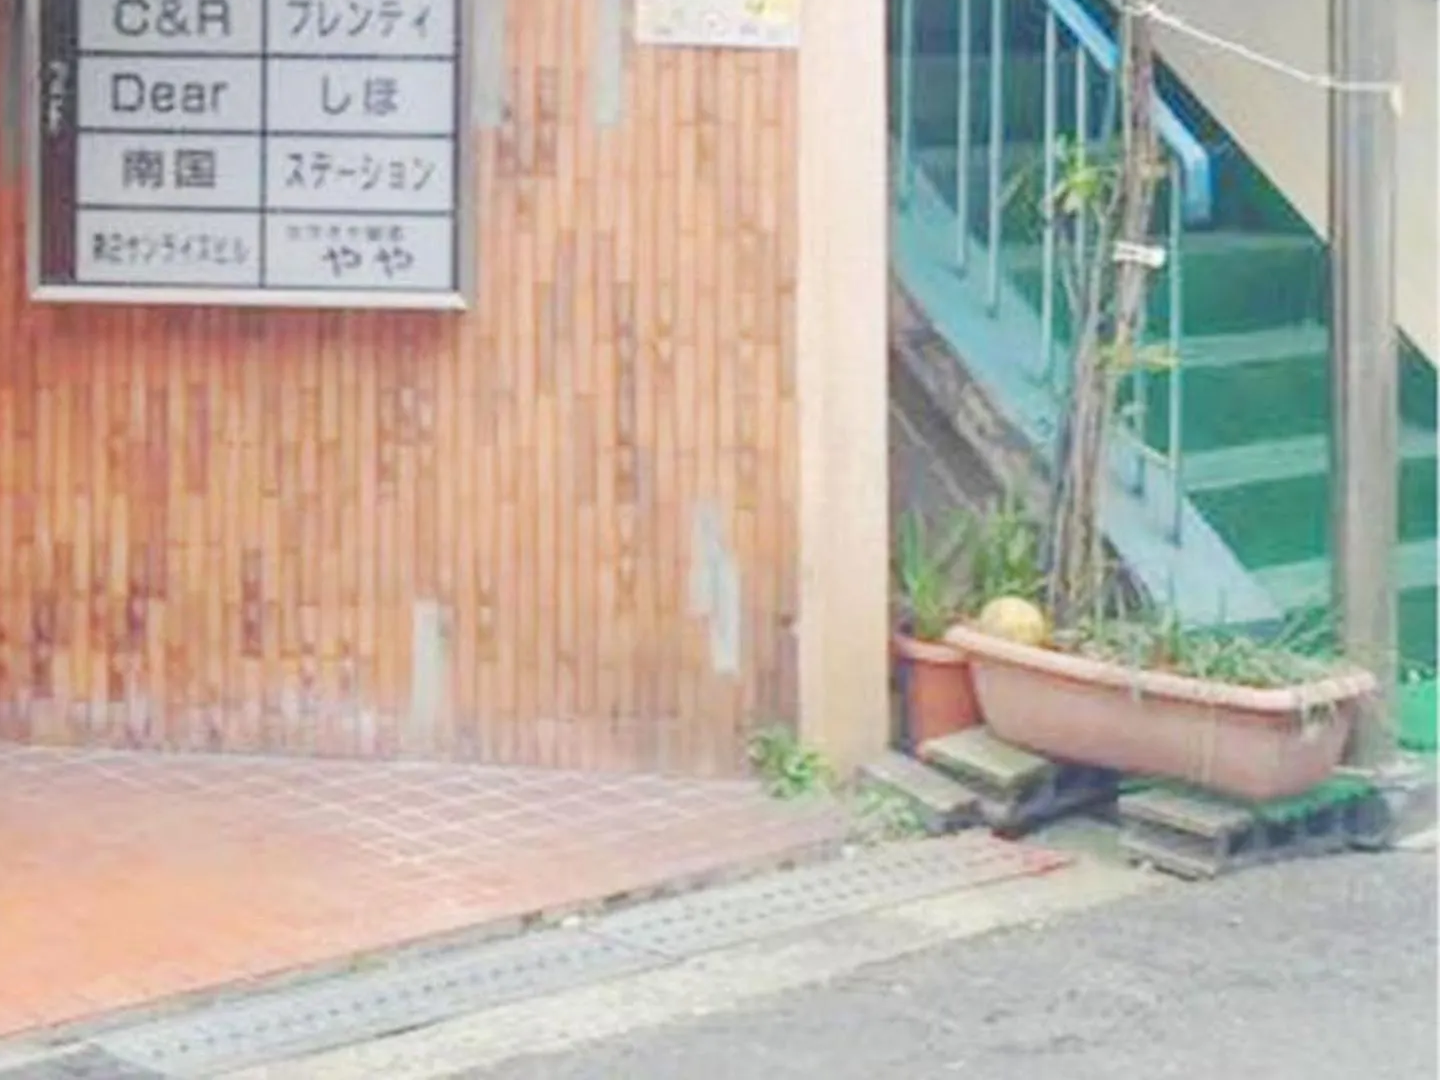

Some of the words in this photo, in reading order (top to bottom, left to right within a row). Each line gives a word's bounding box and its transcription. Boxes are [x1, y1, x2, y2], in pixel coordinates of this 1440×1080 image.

[110, 72, 228, 114] Dear
[321, 76, 400, 116] しほ
[121, 148, 217, 189] 南国
[285, 152, 436, 191] ステーション
[321, 245, 414, 278] やや
